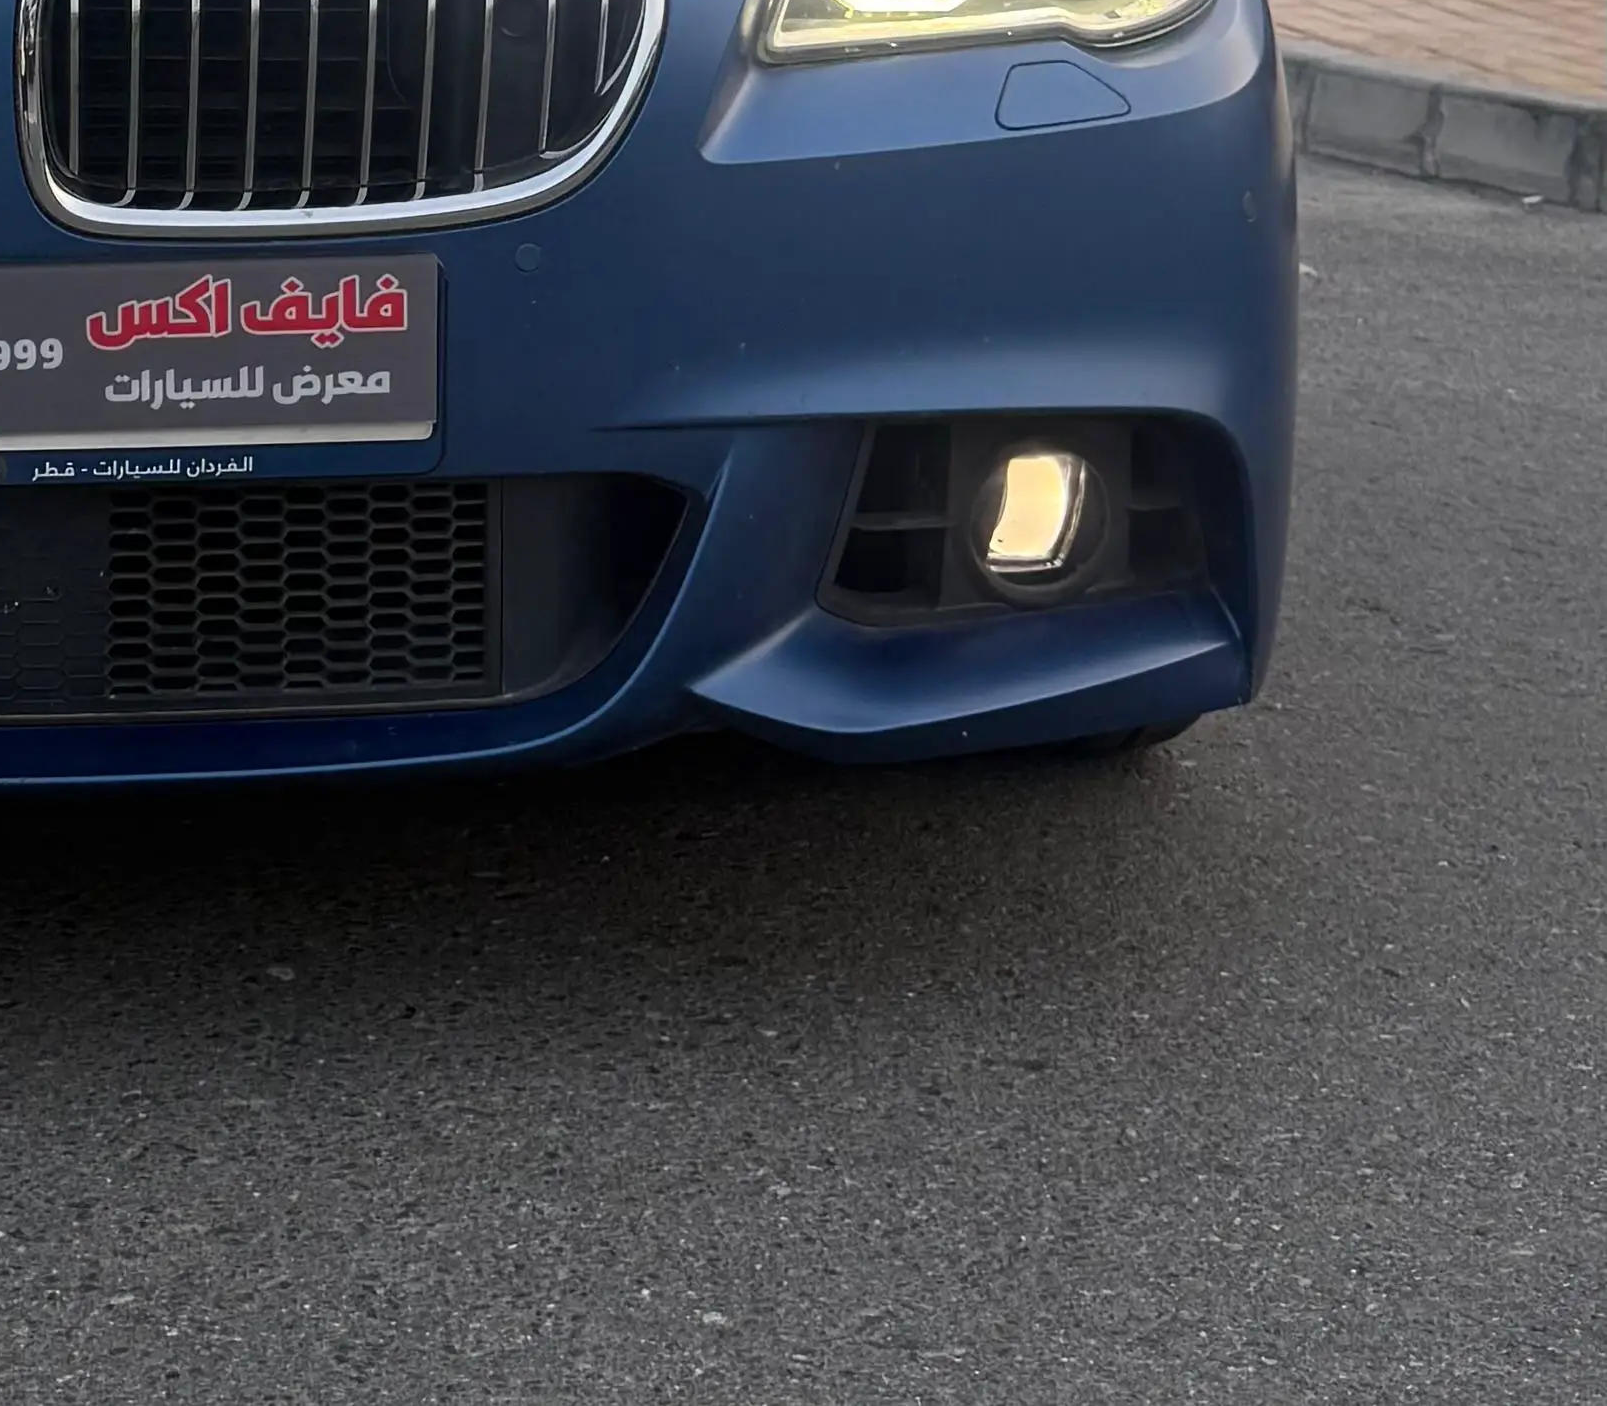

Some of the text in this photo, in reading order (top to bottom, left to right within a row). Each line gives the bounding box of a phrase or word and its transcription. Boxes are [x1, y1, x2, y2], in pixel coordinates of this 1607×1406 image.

[86, 273, 408, 351] فايف اكس
[104, 365, 391, 410] معرض للسيارات
[31, 461, 76, 482] قطر
[92, 458, 182, 480] للسيارات
[186, 456, 254, 478] الفردان
